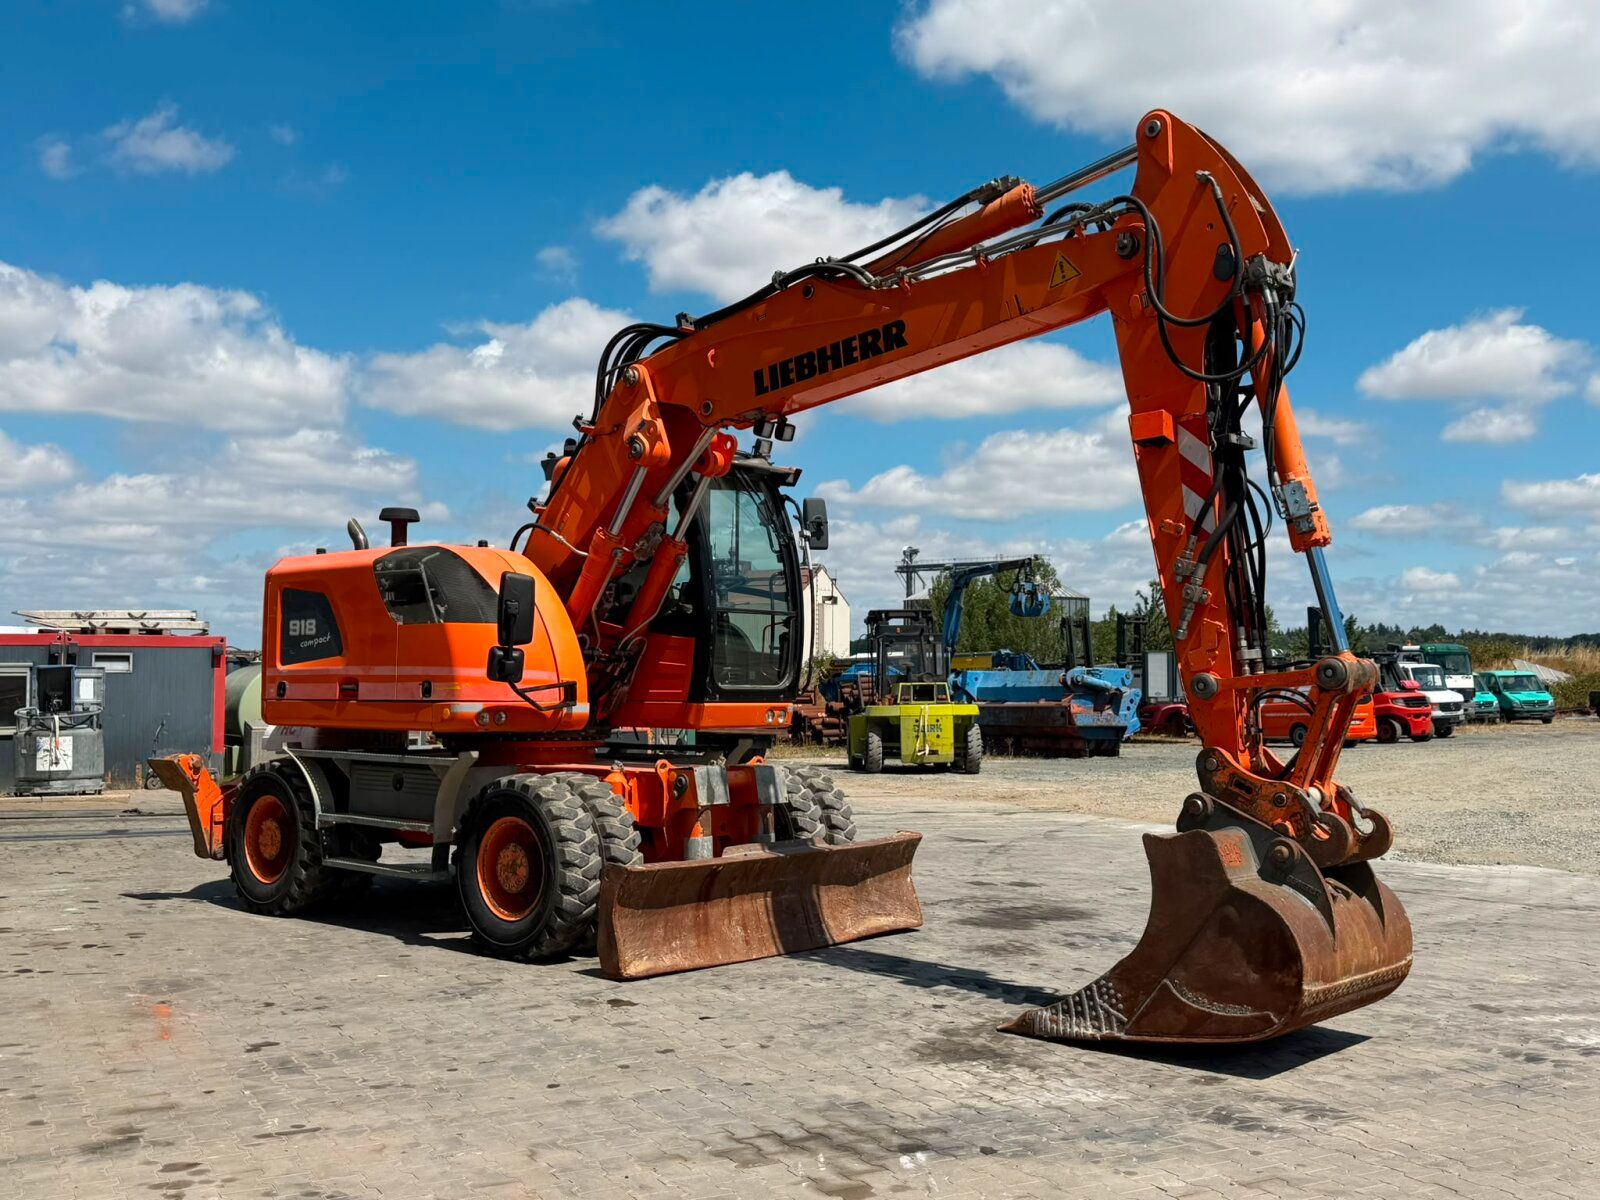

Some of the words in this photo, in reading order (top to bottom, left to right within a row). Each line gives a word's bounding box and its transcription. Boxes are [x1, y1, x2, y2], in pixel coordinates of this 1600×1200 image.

[754, 320, 908, 396] LIEBHERR
[289, 619, 316, 636] 918
[300, 632, 330, 647] compact
